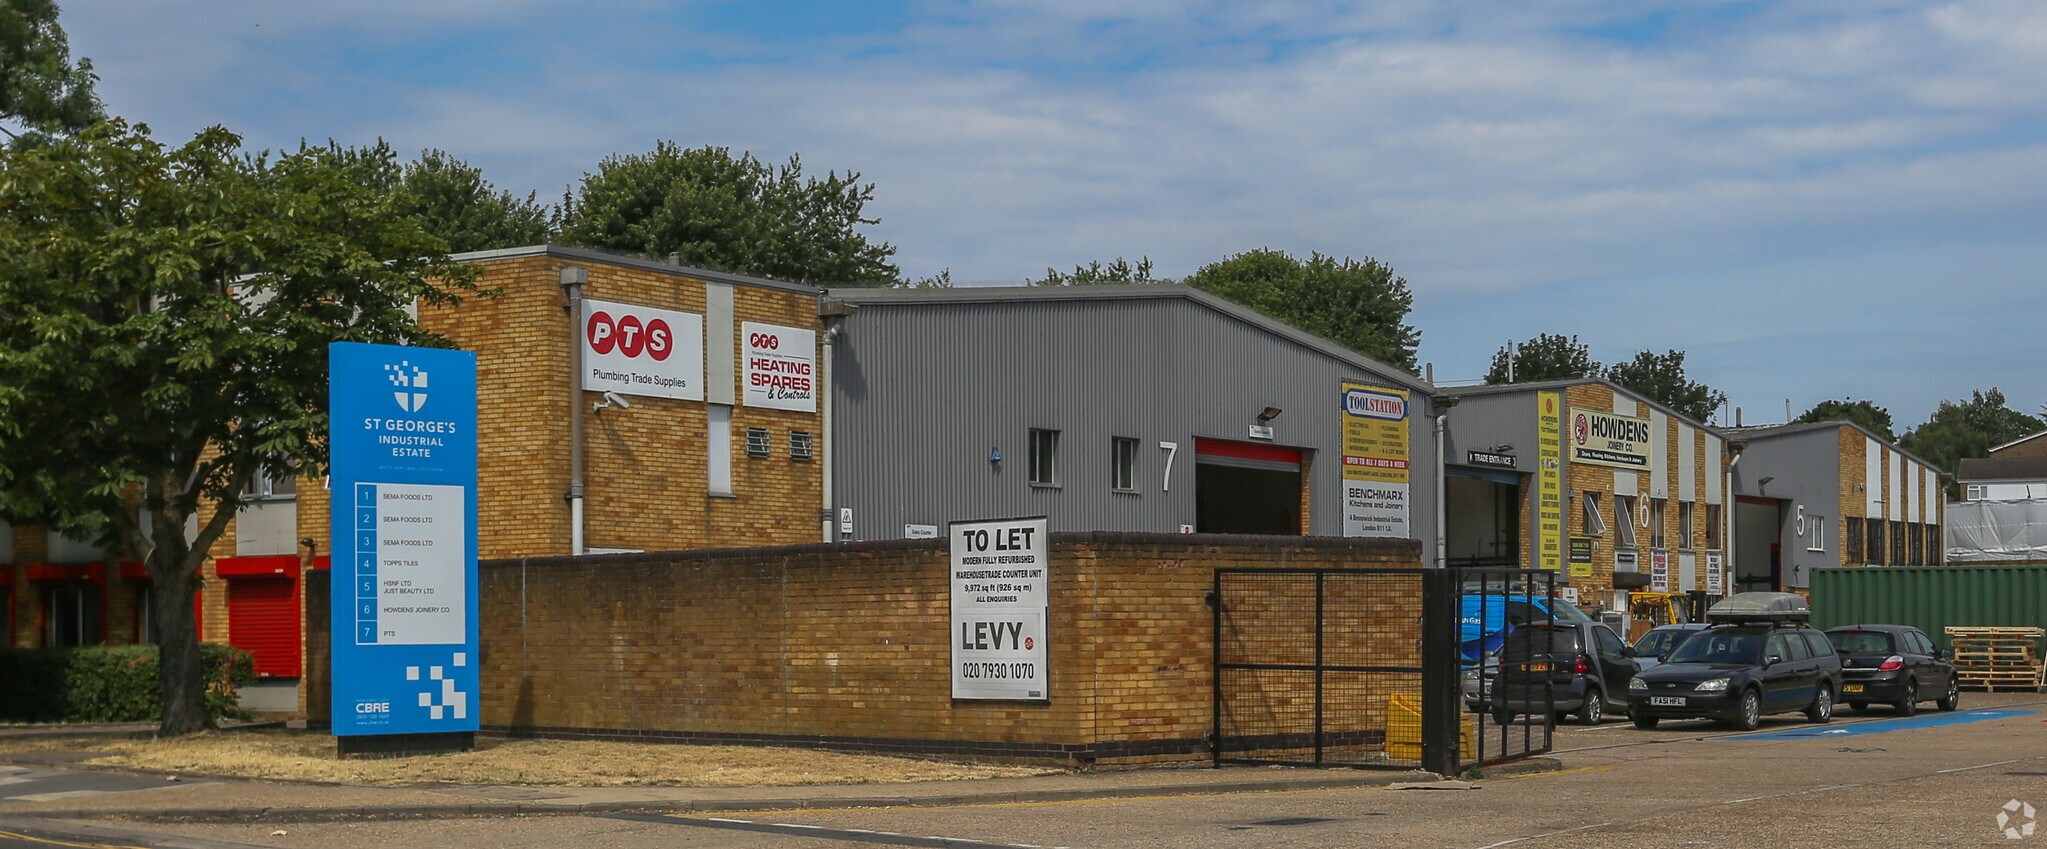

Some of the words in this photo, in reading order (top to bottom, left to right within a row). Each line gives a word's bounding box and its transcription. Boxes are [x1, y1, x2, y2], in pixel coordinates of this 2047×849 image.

[592, 320, 668, 353] PTS
[751, 358, 811, 375] HEATING
[593, 369, 629, 384] Plumbing
[631, 372, 652, 384] Trade
[654, 375, 686, 388] Supplies
[751, 373, 811, 391] SPARES
[768, 387, 774, 399] &
[778, 387, 811, 399] Controls
[1349, 396, 1402, 414] TOOLSTATION
[365, 418, 381, 430] ST
[385, 419, 456, 433] GEORGE'S
[1591, 415, 1649, 443] HOWDENS
[379, 435, 443, 446] INDUSTRIAL
[1607, 441, 1624, 451] JOINERY
[1625, 443, 1633, 452] CO.
[392, 448, 431, 458] ESTATE
[1475, 453, 1488, 463] TRADE
[1489, 455, 1511, 465] ENTRANCE
[1160, 441, 1177, 491] 7
[364, 491, 369, 500] 1
[1349, 488, 1403, 501] BENCHMARX
[1385, 502, 1403, 510] Joinery
[1639, 492, 1649, 528] 6
[364, 514, 370, 523] 2
[1796, 505, 1805, 536] 5
[364, 537, 370, 546] 3
[963, 529, 989, 552] TO
[996, 528, 1035, 550] LET
[364, 560, 369, 568] 4
[962, 556, 981, 565] MODERN
[983, 556, 997, 564] FULLY
[998, 555, 1035, 564] REFURBISHED
[956, 570, 1001, 579] WAREHOUSETRADE
[1003, 570, 1028, 578] COUNTER
[1029, 569, 1042, 578] UNIT
[364, 582, 370, 591] 5
[965, 585, 980, 593] 9,972
[982, 585, 989, 593] sq
[997, 584, 1011, 592] (926
[1023, 584, 1032, 592] m)
[364, 605, 370, 614] 6
[364, 628, 370, 637] 7
[962, 622, 1023, 650] LEVY
[963, 662, 980, 678] 020
[982, 663, 1007, 679] 7930
[1010, 663, 1034, 679] 1070
[356, 702, 390, 713] CBRE
